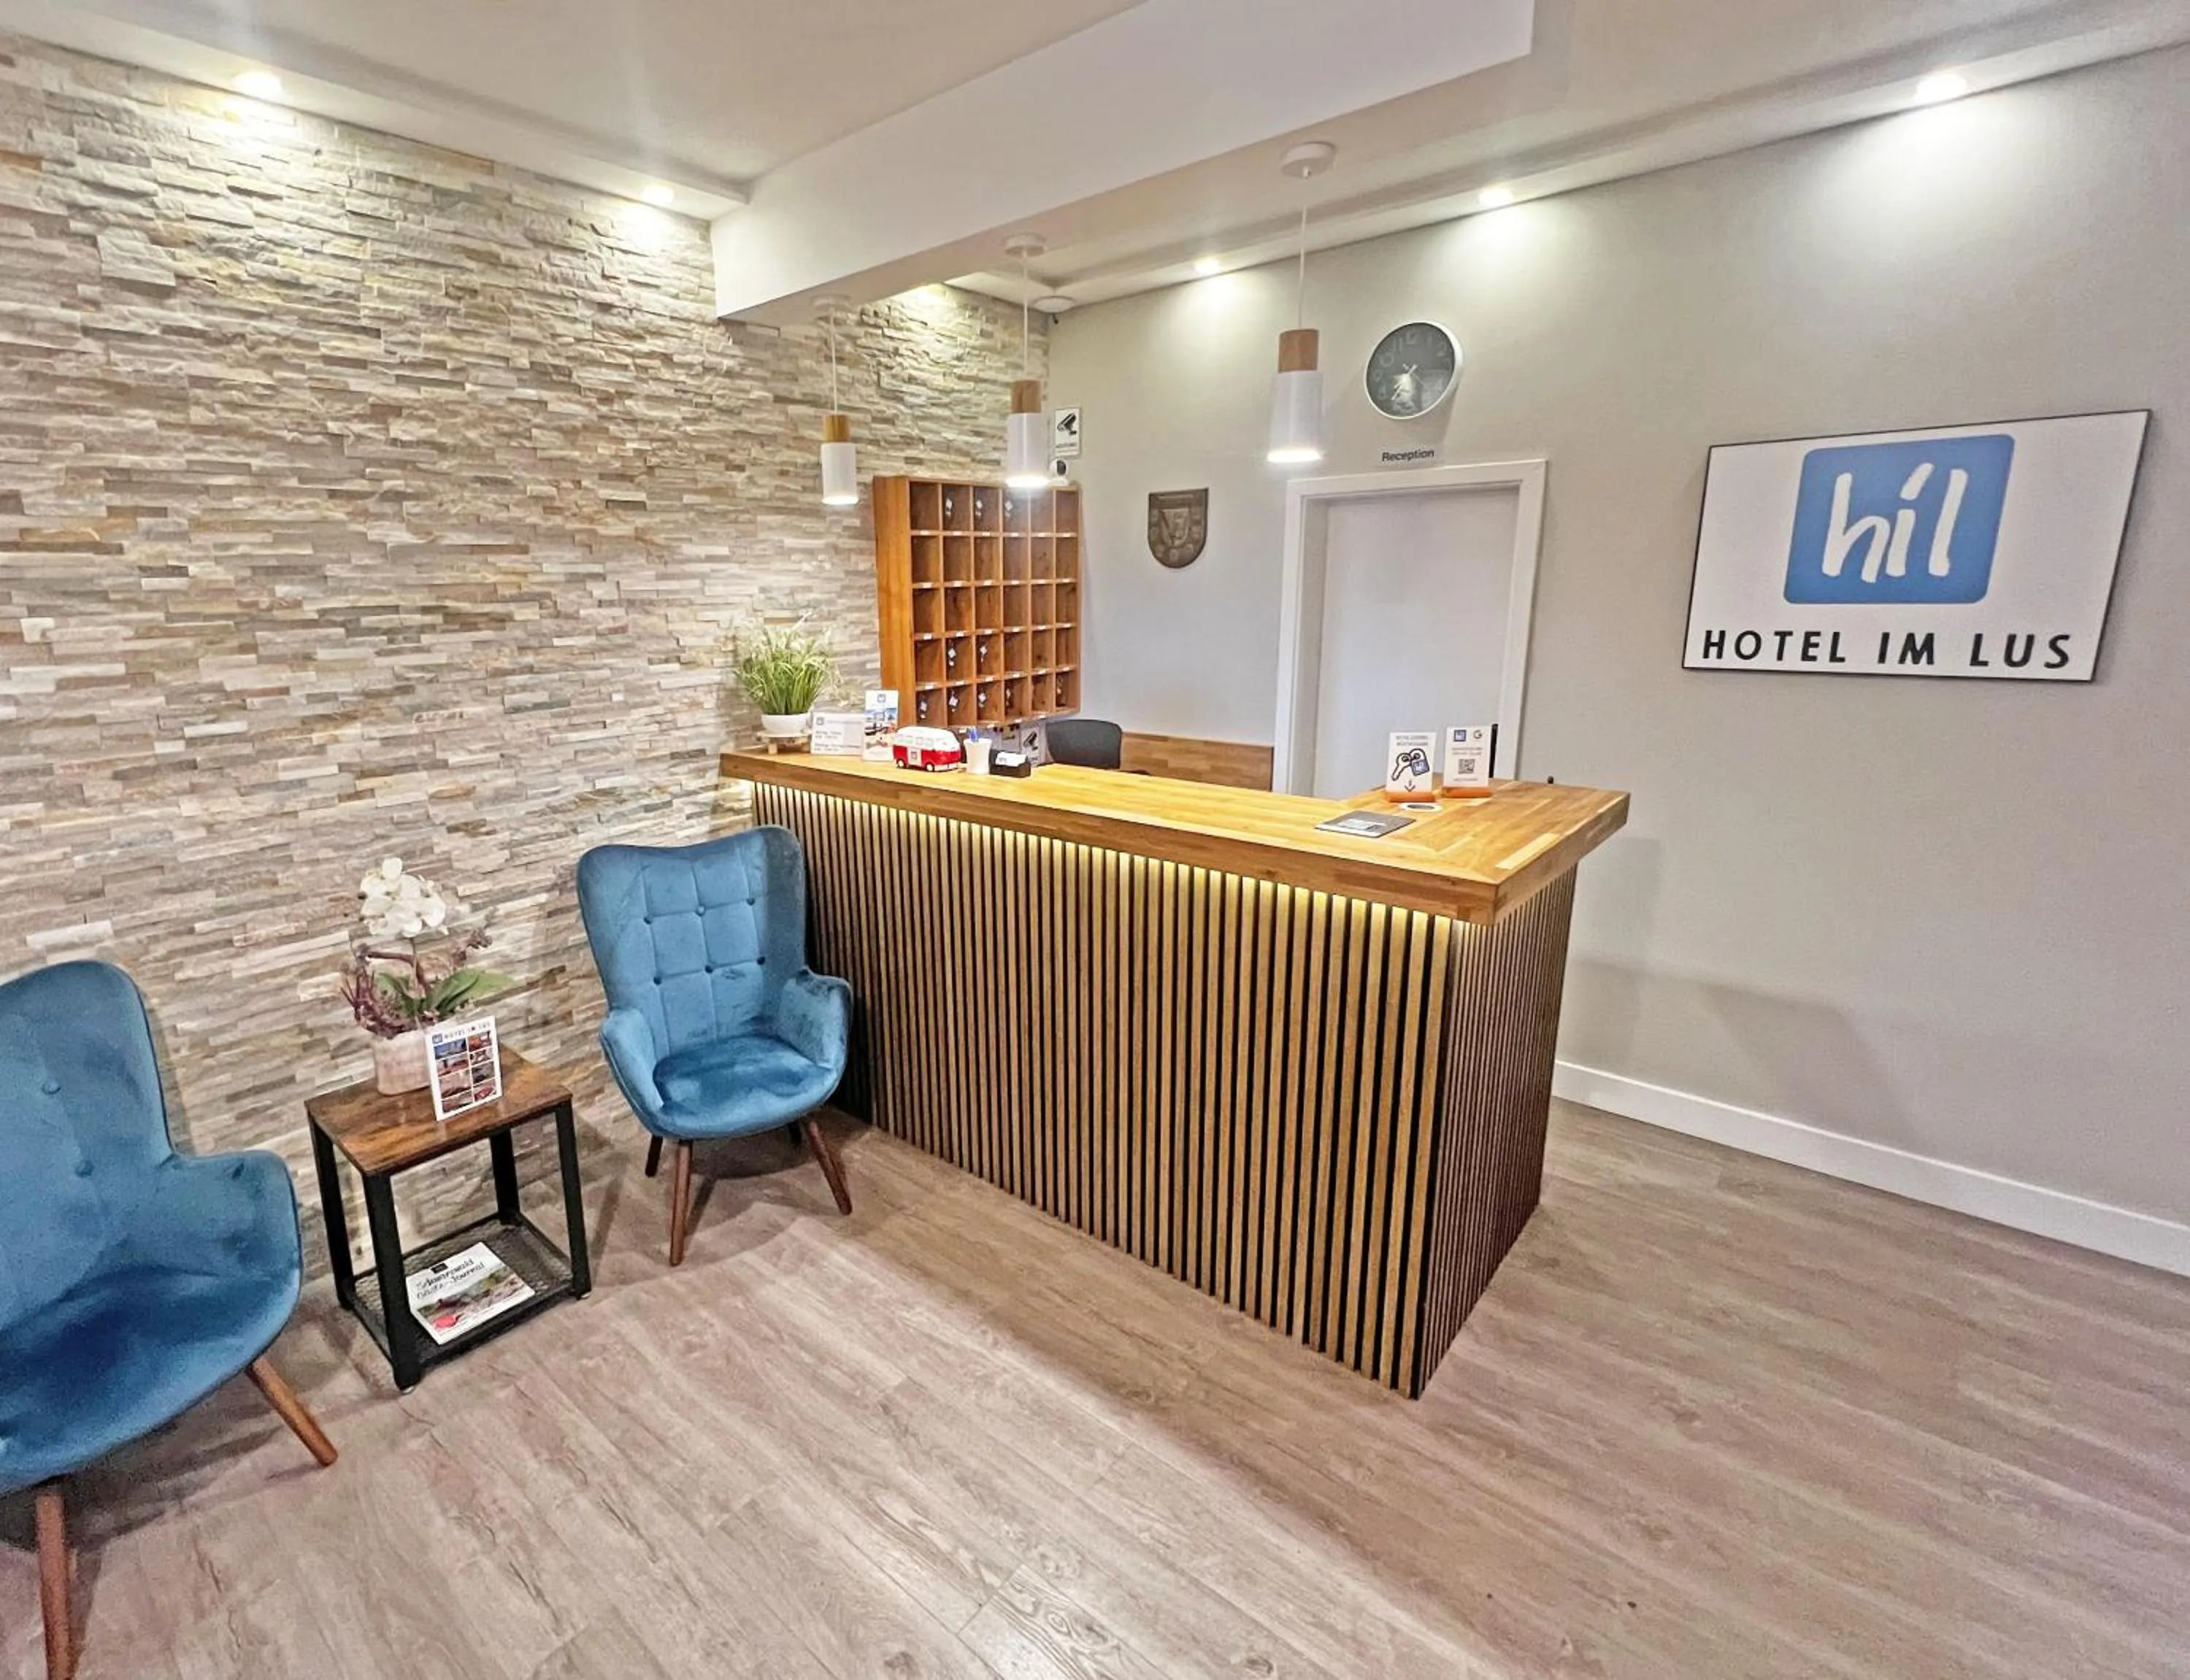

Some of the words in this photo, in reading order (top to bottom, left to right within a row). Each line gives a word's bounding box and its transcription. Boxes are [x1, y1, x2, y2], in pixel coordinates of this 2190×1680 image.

[1381, 449, 1434, 462] Reception
[1821, 462, 1968, 583] hil
[1702, 630, 1847, 663] HOTEL
[1878, 632, 1936, 666] IM
[1970, 633, 2072, 669] LUS
